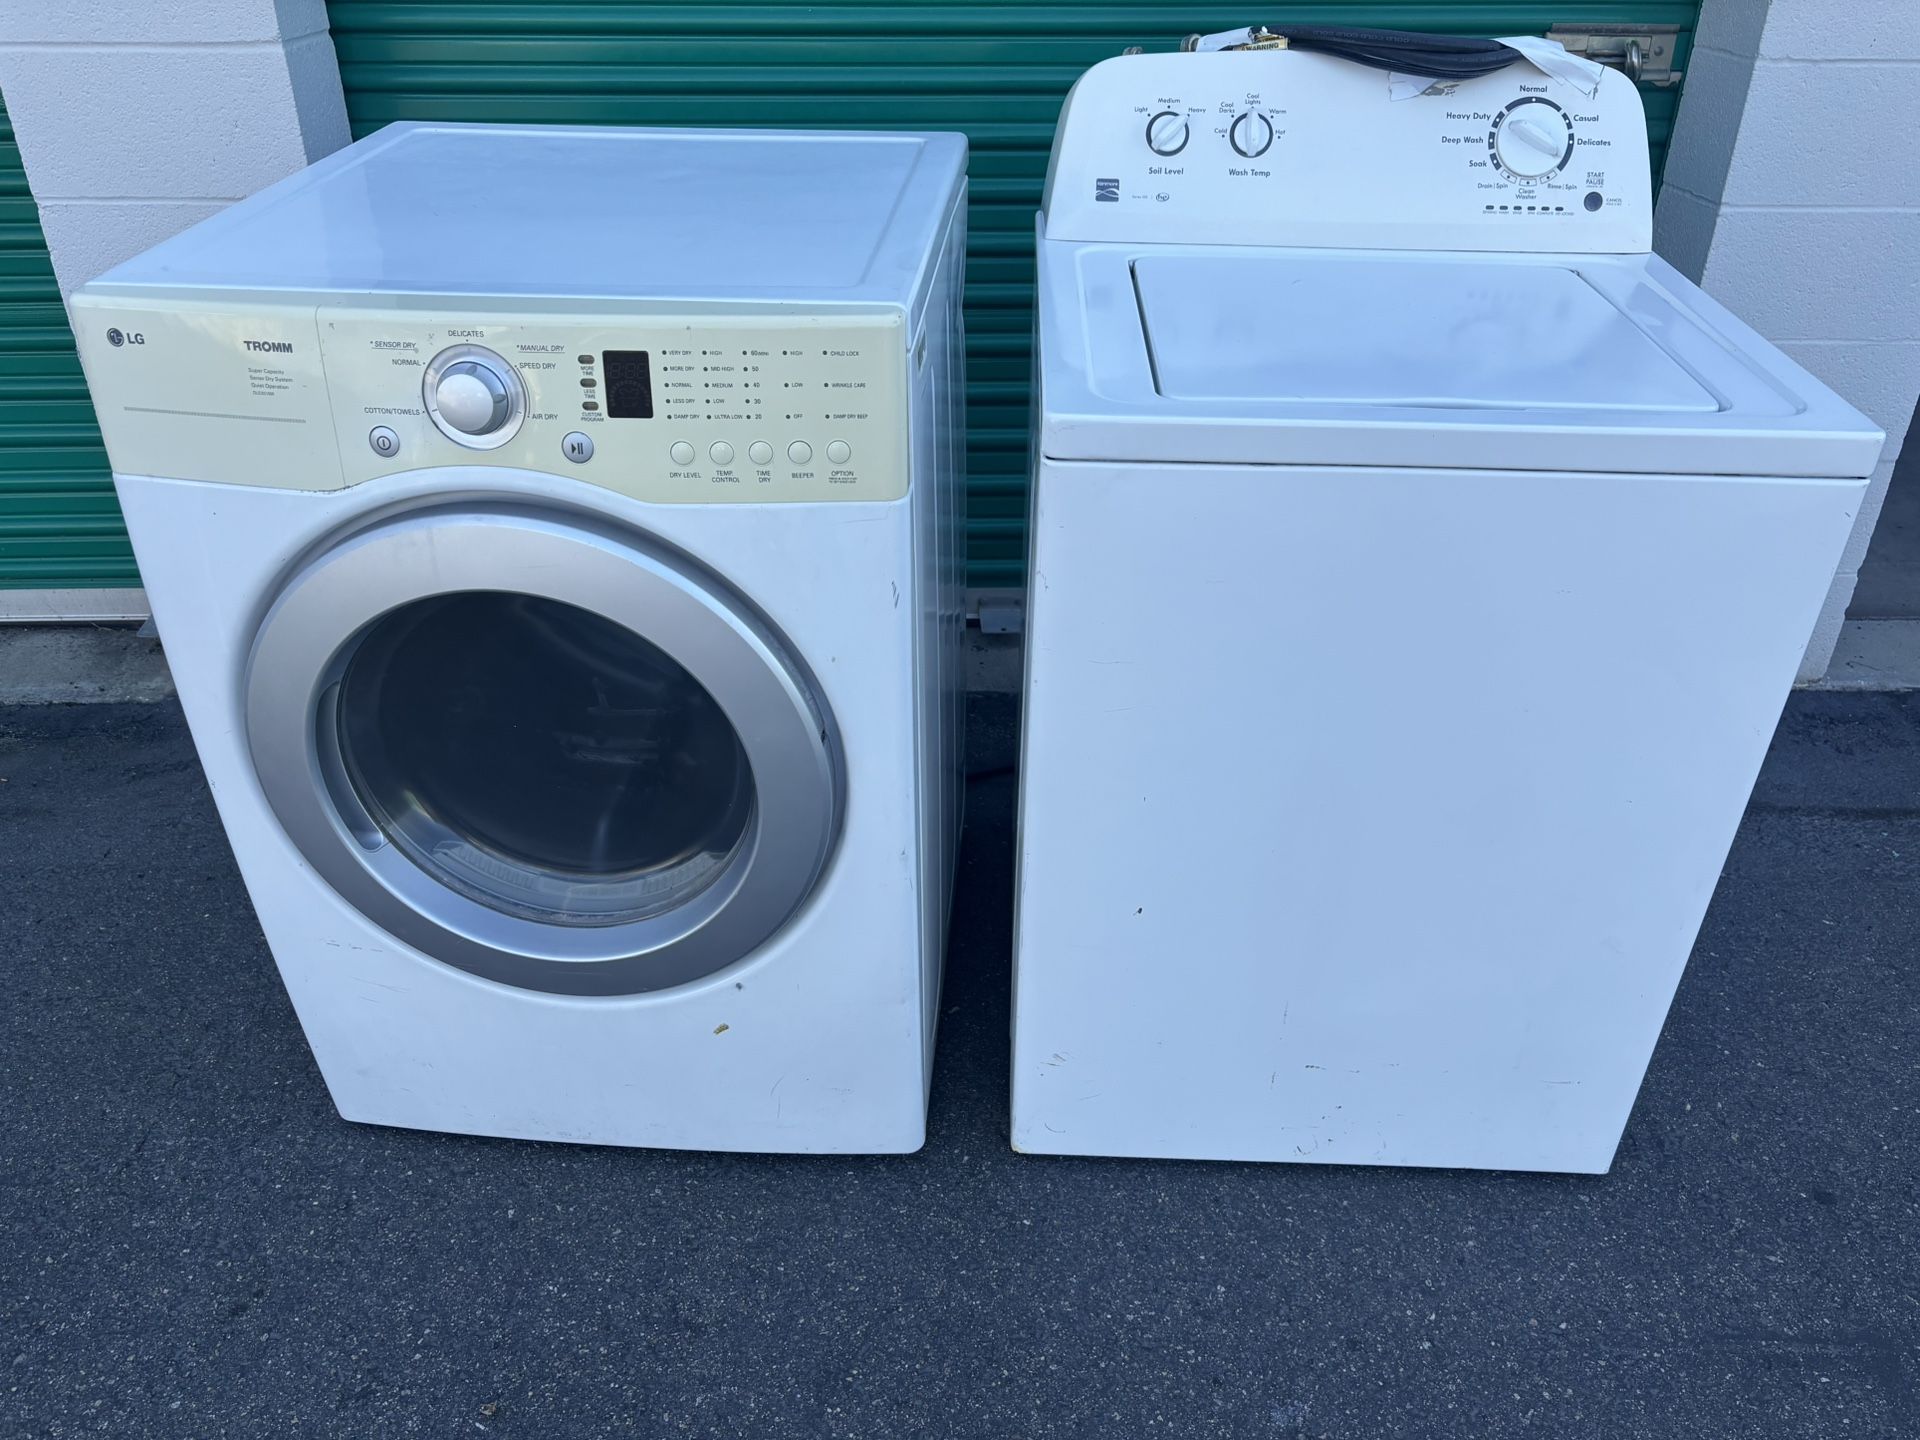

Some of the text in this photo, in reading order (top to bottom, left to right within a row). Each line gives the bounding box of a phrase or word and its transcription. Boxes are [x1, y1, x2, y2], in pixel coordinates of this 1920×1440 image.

[1245, 42, 1279, 51] WARNING
[1520, 85, 1548, 93] Normal
[1446, 112, 1491, 121] Heavy Duty
[1573, 114, 1599, 122] Casual
[1441, 136, 1484, 145] Deep Wash
[1577, 138, 1611, 147] Delicates
[1469, 160, 1487, 168] Soak
[1148, 166, 1184, 175] Soil Level
[1229, 168, 1271, 178] Wash Temp
[126, 332, 145, 345] LG
[448, 330, 484, 338] DELICATES
[244, 340, 293, 353] TROMM
[364, 407, 420, 415] COTTON/TOWELS
